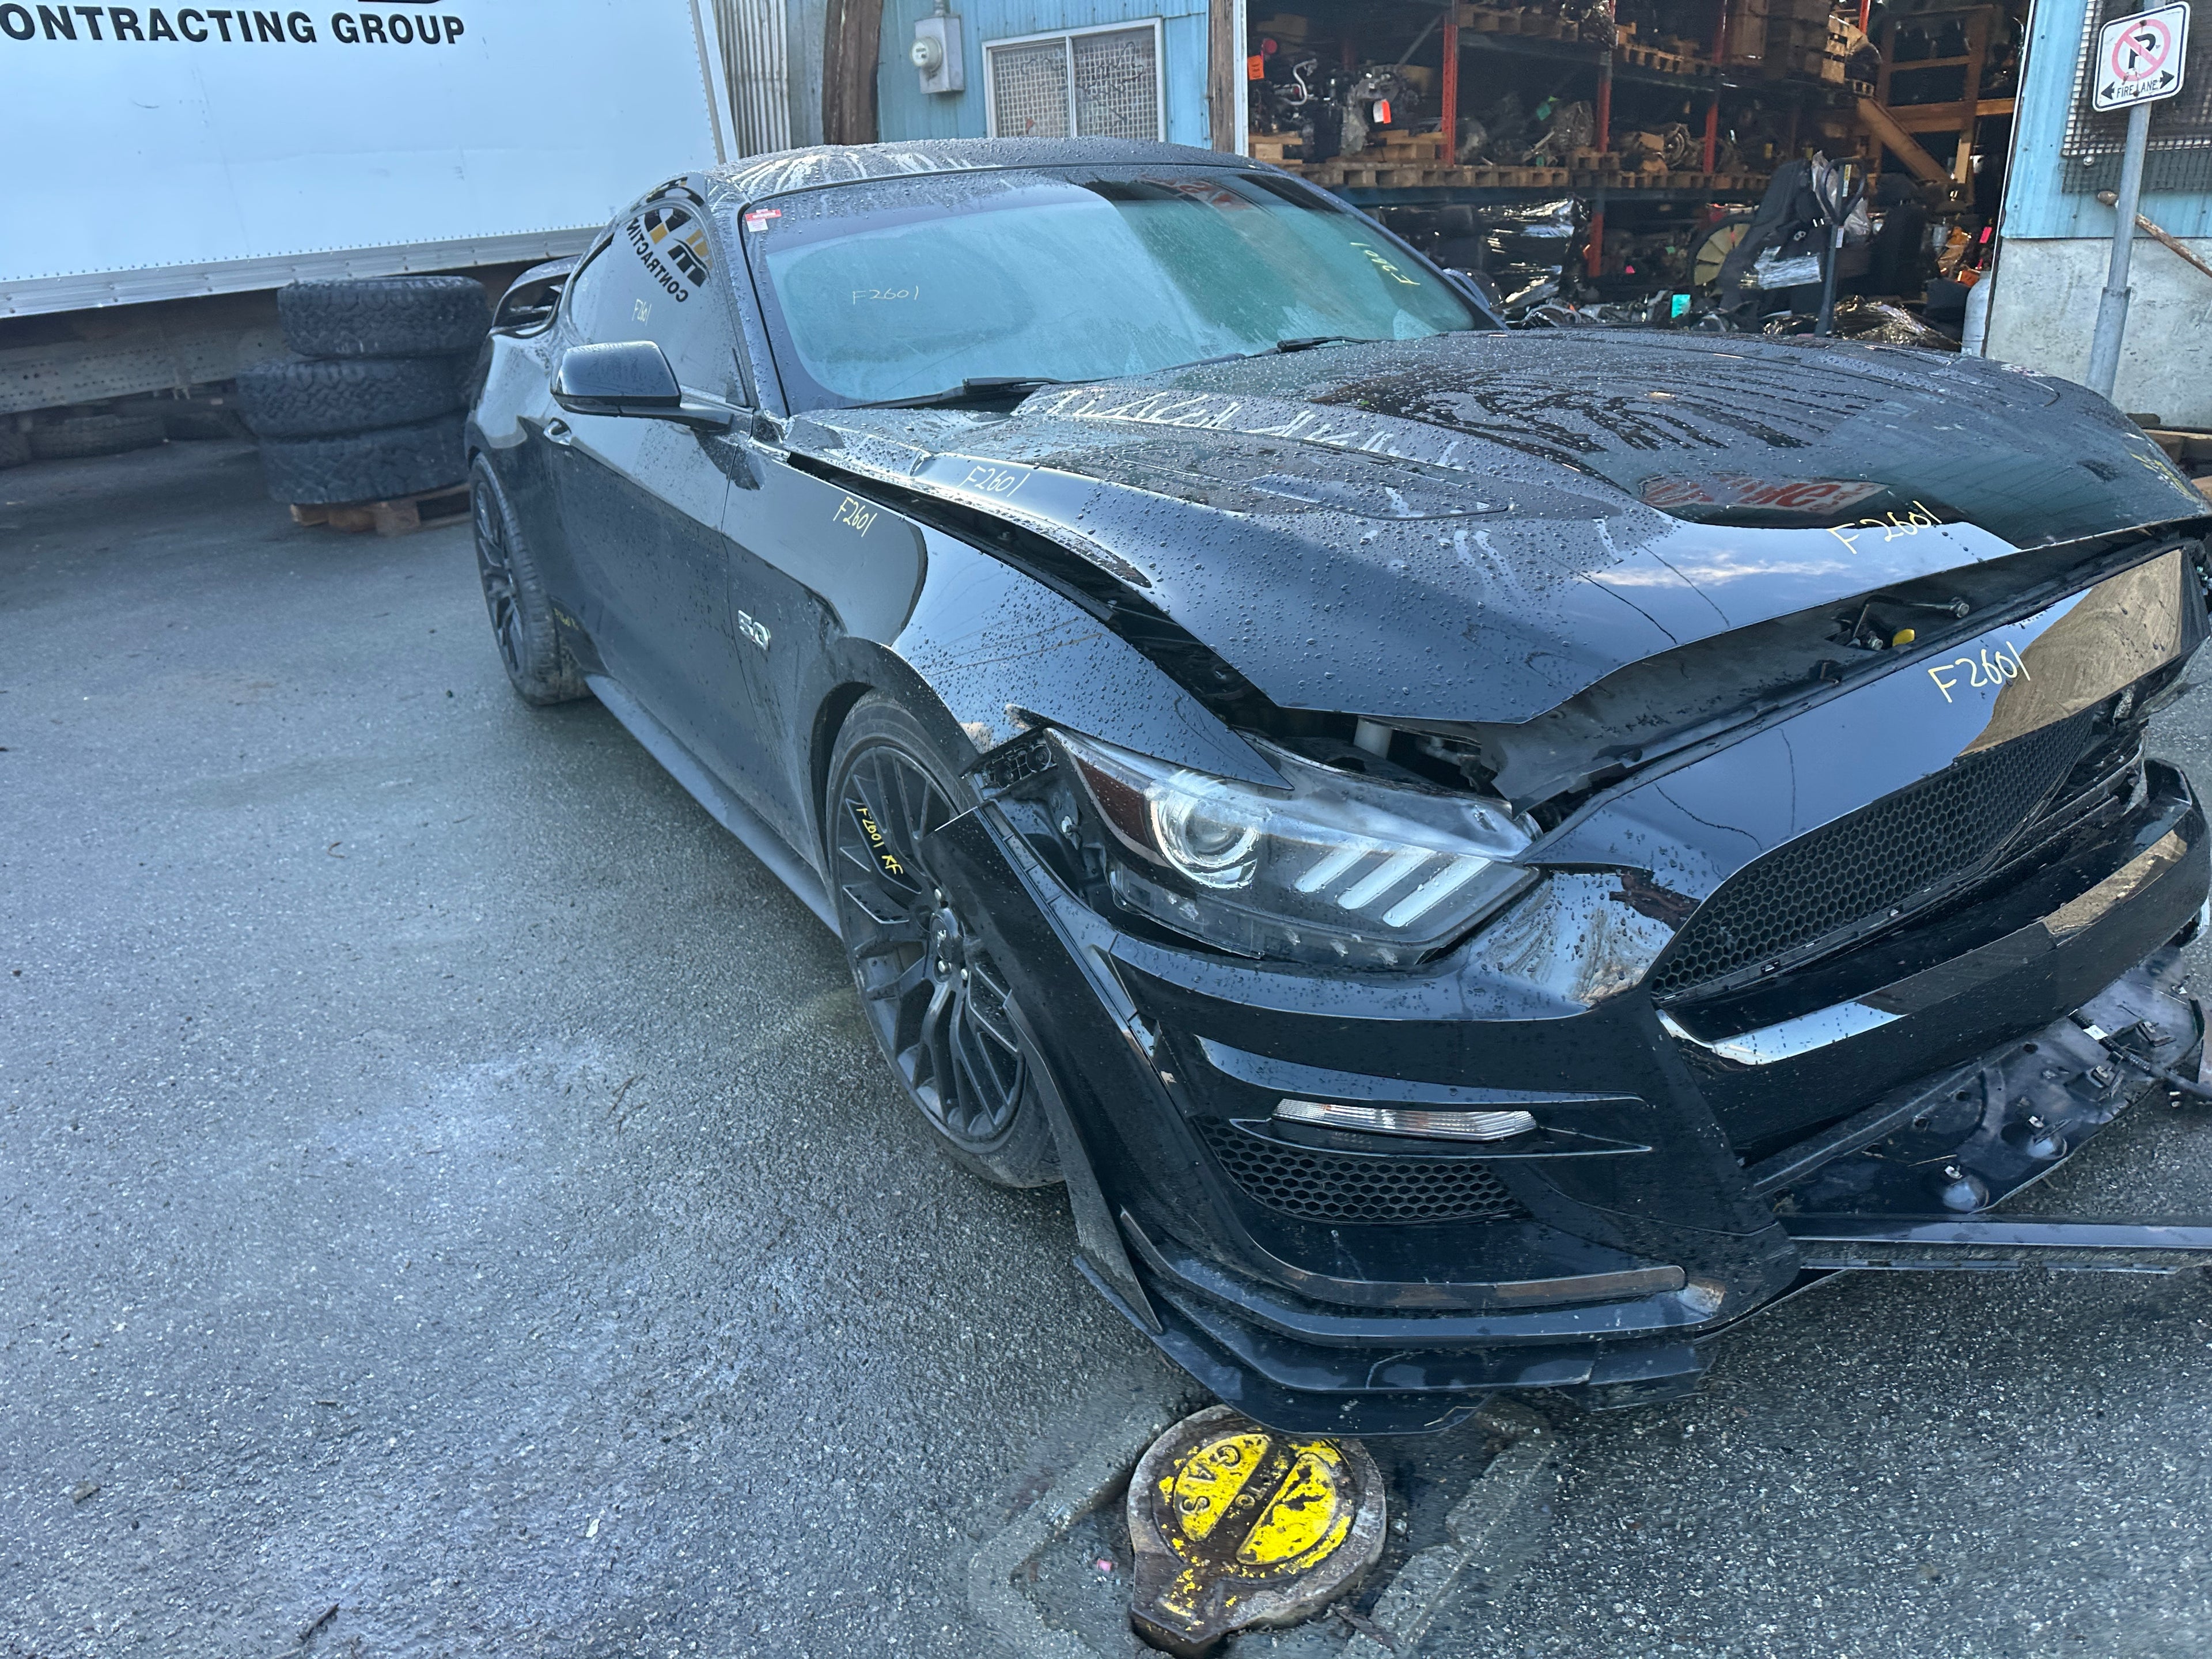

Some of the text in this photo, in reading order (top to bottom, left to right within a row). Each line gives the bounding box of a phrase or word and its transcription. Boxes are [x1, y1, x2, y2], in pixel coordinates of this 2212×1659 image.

[332, 12, 464, 44] GROUP
[2116, 84, 2134, 99] FIRE
[853, 285, 919, 305] F2601
[957, 465, 1031, 497] F2601
[833, 497, 878, 537] F2601
[1827, 500, 1942, 555] F2601
[1928, 641, 2031, 703] F2601
[1179, 1444, 1241, 1515] GAS
